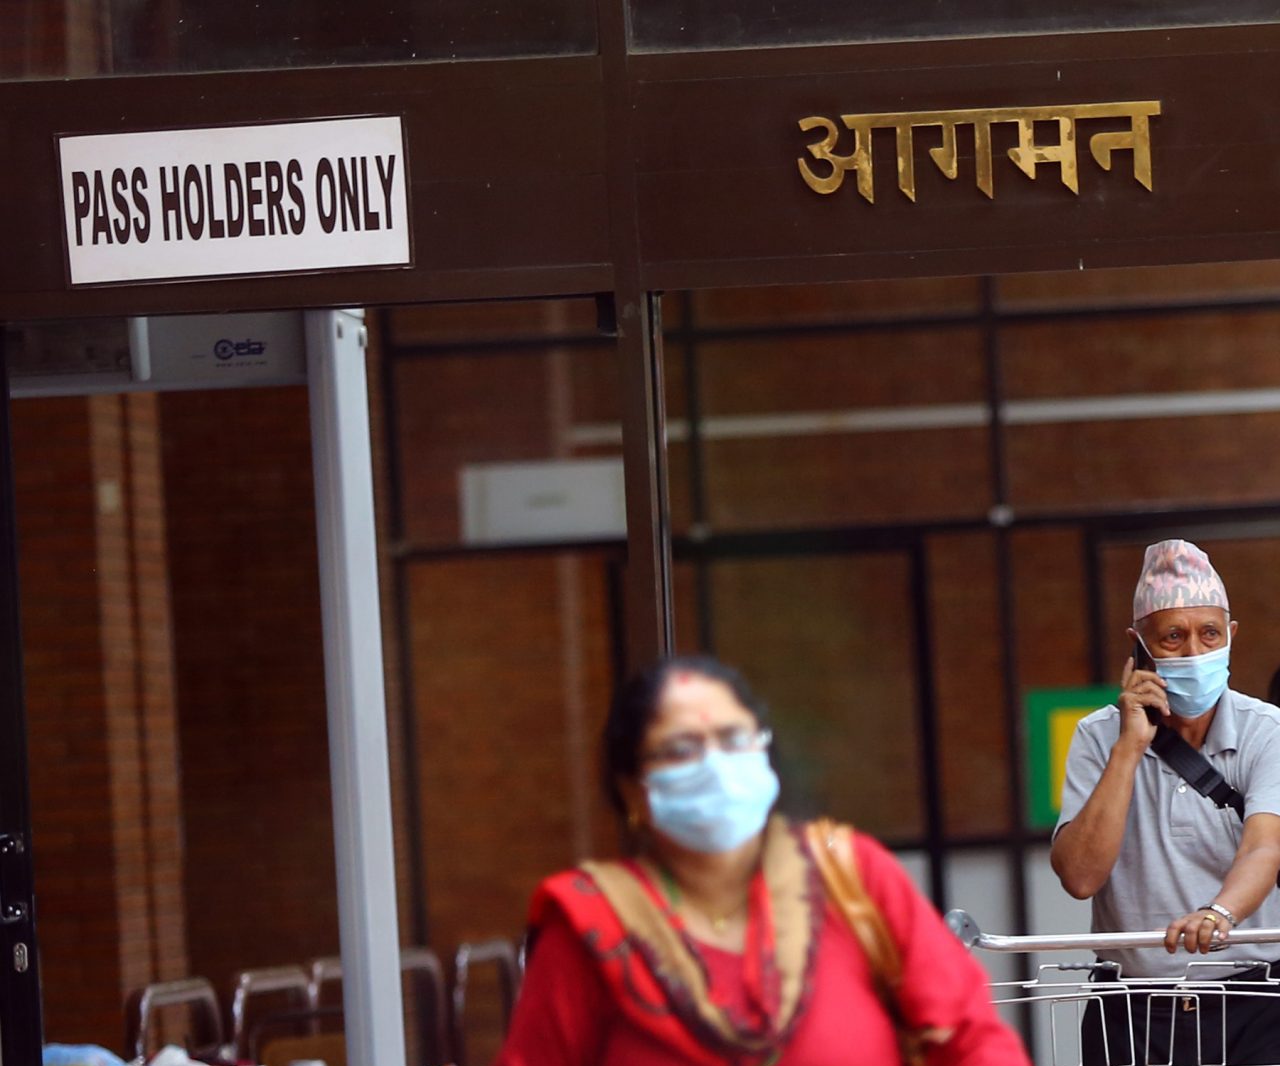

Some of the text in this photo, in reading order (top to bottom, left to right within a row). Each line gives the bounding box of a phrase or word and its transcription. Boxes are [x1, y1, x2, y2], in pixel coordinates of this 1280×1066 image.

[71, 154, 396, 246] PASS HOLDERS ONLY
[797, 100, 1161, 204] आगमन
